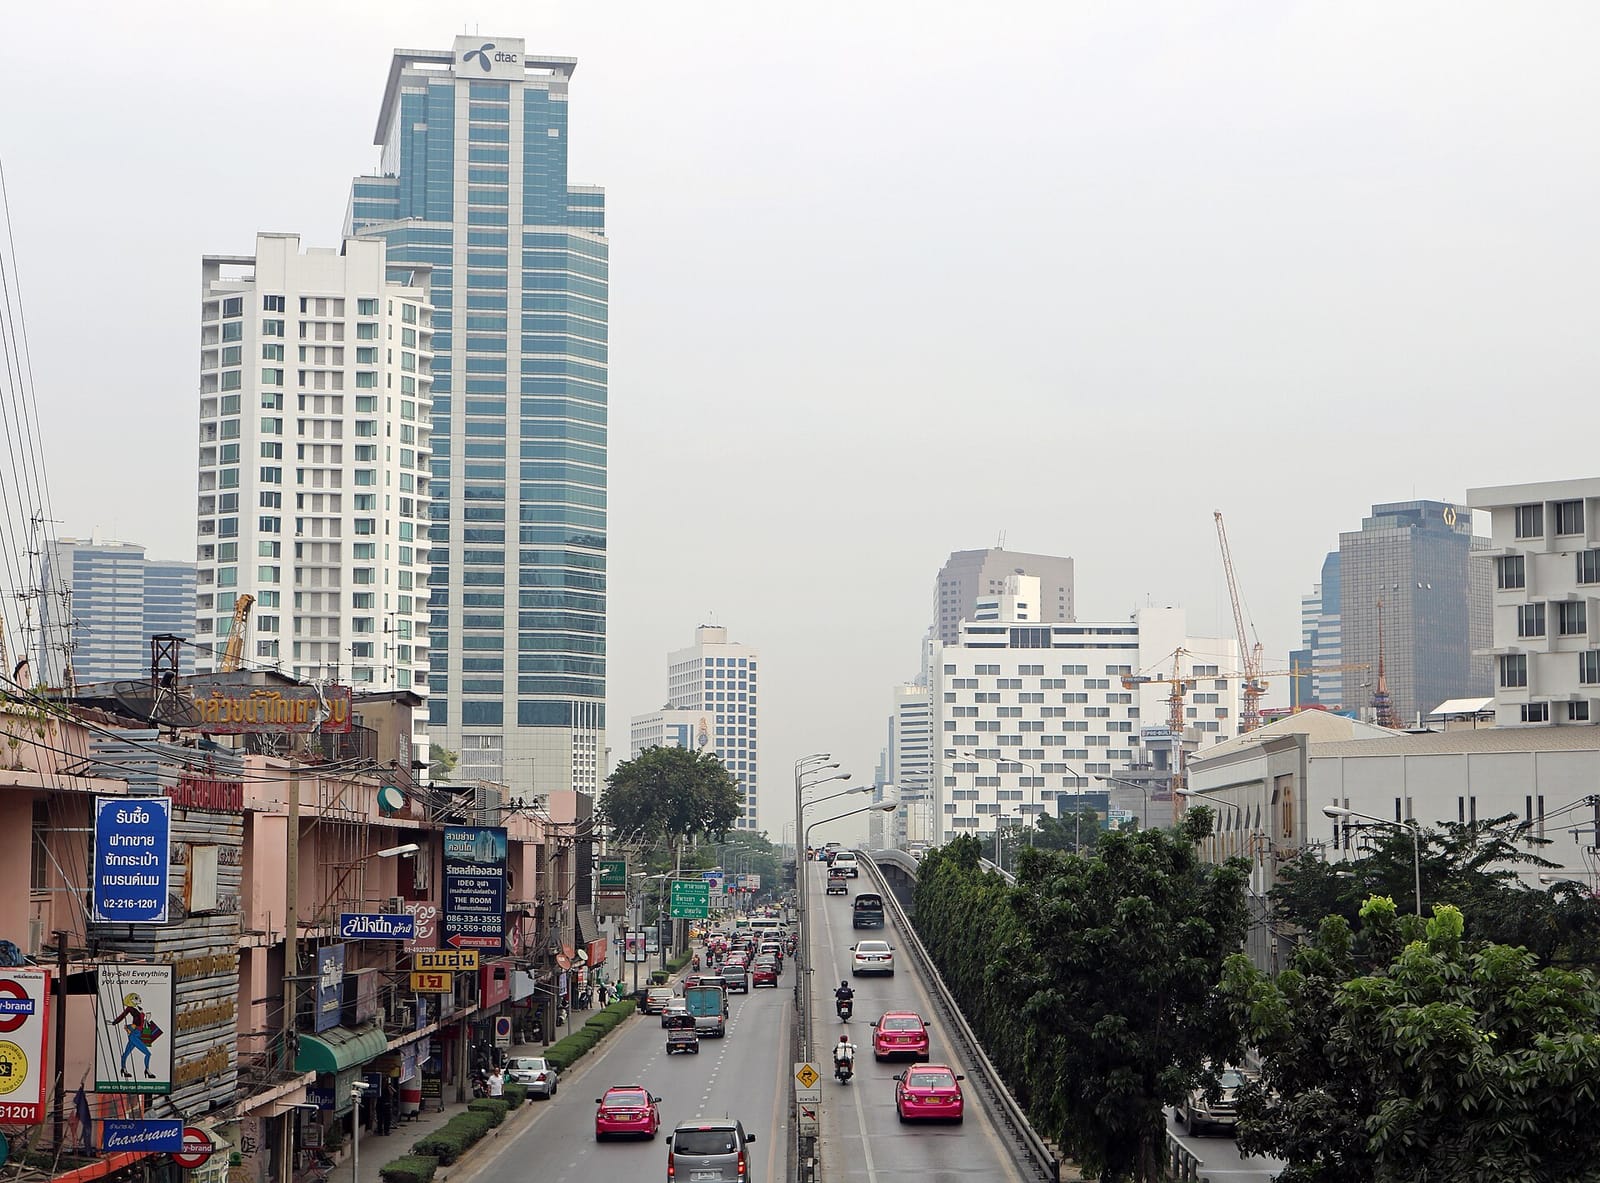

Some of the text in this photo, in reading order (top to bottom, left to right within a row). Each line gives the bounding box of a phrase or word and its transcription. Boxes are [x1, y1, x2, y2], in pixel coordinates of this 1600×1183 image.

[494, 51, 517, 63] dtac
[116, 807, 149, 824] รับซื้อ
[109, 833, 155, 846] ฝากขาย
[446, 832, 475, 841] สามย่าน
[105, 851, 159, 866] ซักกระเป๋า
[102, 873, 160, 886] แบรนด์เนม
[103, 899, 157, 909] 02-216-1201
[454, 896, 468, 904] THE
[446, 915, 502, 923] 086-334-3555
[343, 916, 393, 936] สมใจนึก
[446, 924, 502, 932] 092-559-0808
[421, 950, 475, 970] อบอุ่น
[101, 970, 169, 978] Buy-Sell Everything
[108, 1127, 178, 1148] brandname
